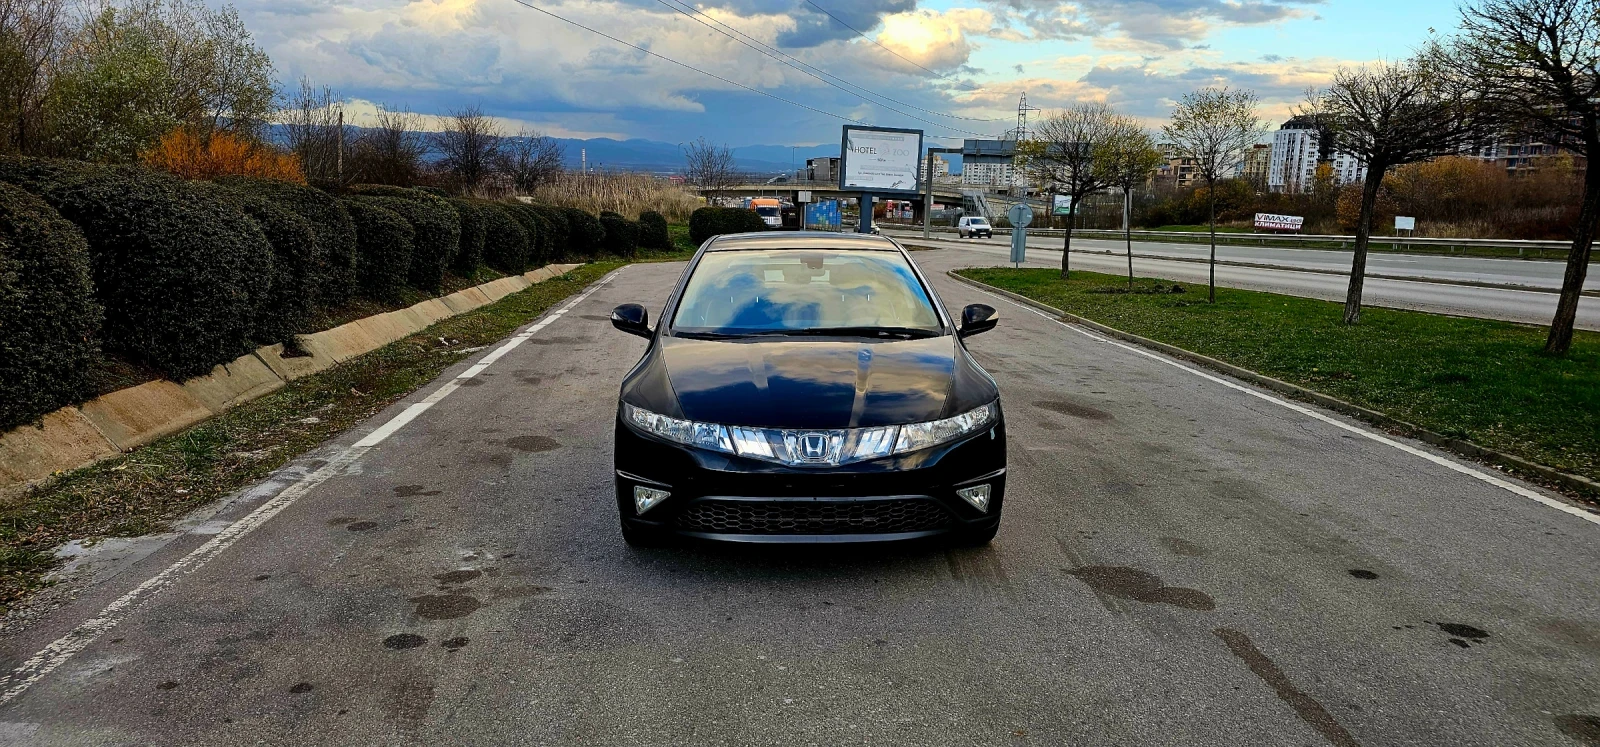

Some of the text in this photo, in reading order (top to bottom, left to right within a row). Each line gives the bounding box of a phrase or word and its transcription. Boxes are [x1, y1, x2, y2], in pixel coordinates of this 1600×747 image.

[854, 146, 877, 154] HOTEL
[1257, 214, 1289, 222] VIMAX
[1255, 221, 1301, 229] КЛИМАТИЦИ
